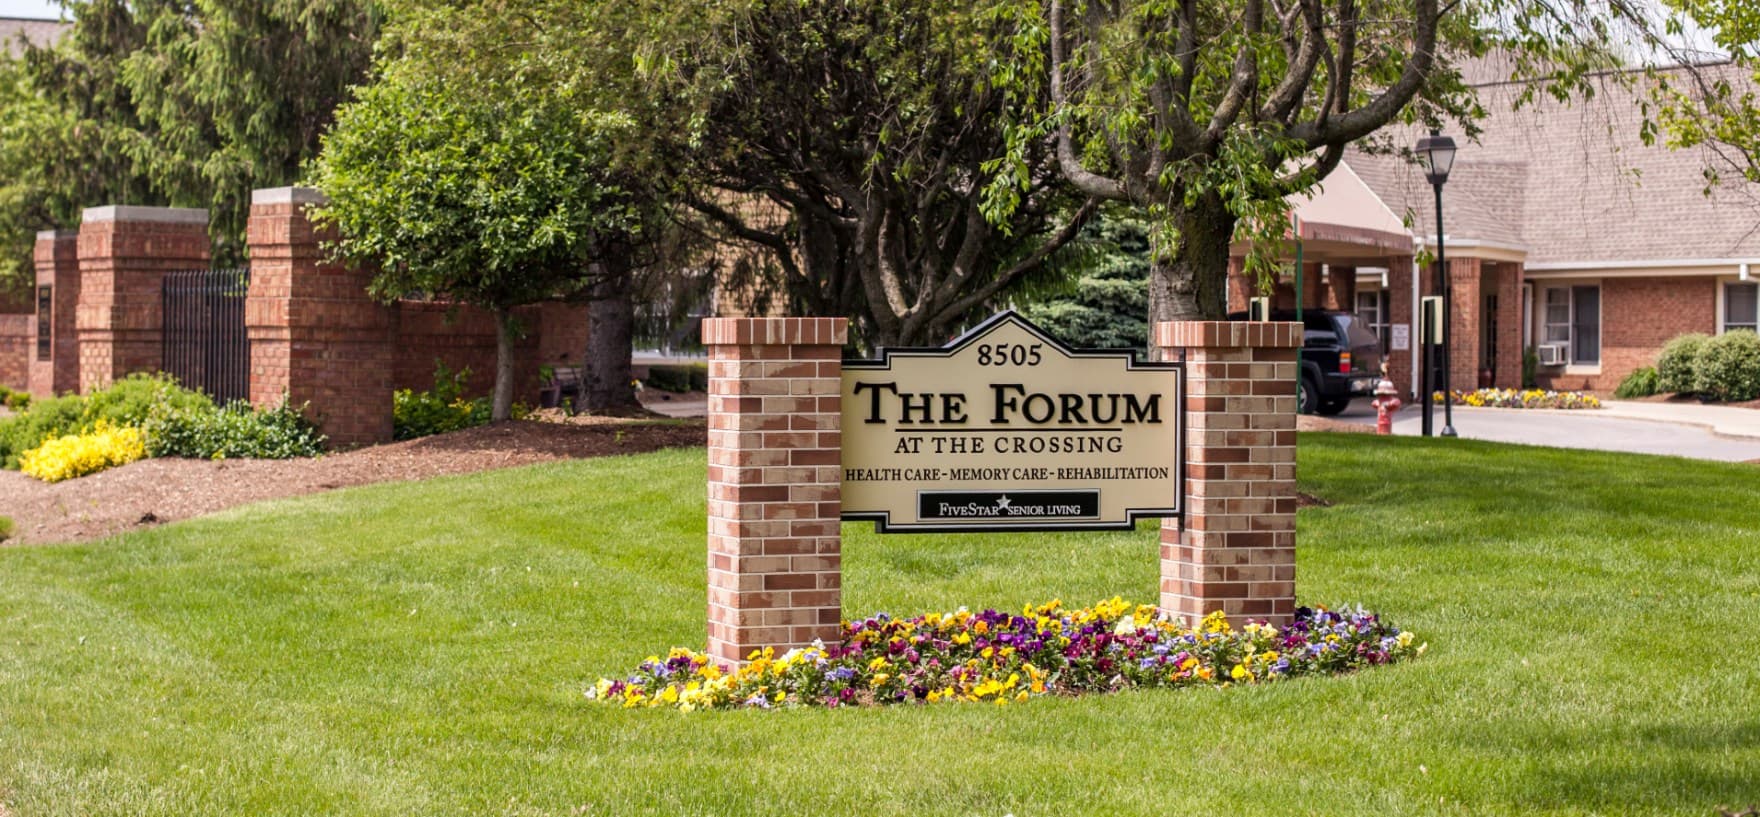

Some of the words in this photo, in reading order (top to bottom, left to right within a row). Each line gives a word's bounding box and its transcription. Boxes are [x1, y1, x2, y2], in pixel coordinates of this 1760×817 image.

[977, 343, 1043, 366] 8505
[853, 381, 968, 424] THE
[989, 383, 1163, 425] FORUM
[894, 436, 923, 454] AT
[931, 436, 985, 454] THE
[994, 436, 1124, 454] CROSSING
[845, 468, 901, 481] HEALTH
[1057, 466, 1169, 480] REHABILITATION
[1007, 505, 1045, 516] SENIOR
[1047, 504, 1081, 516] LIVING
